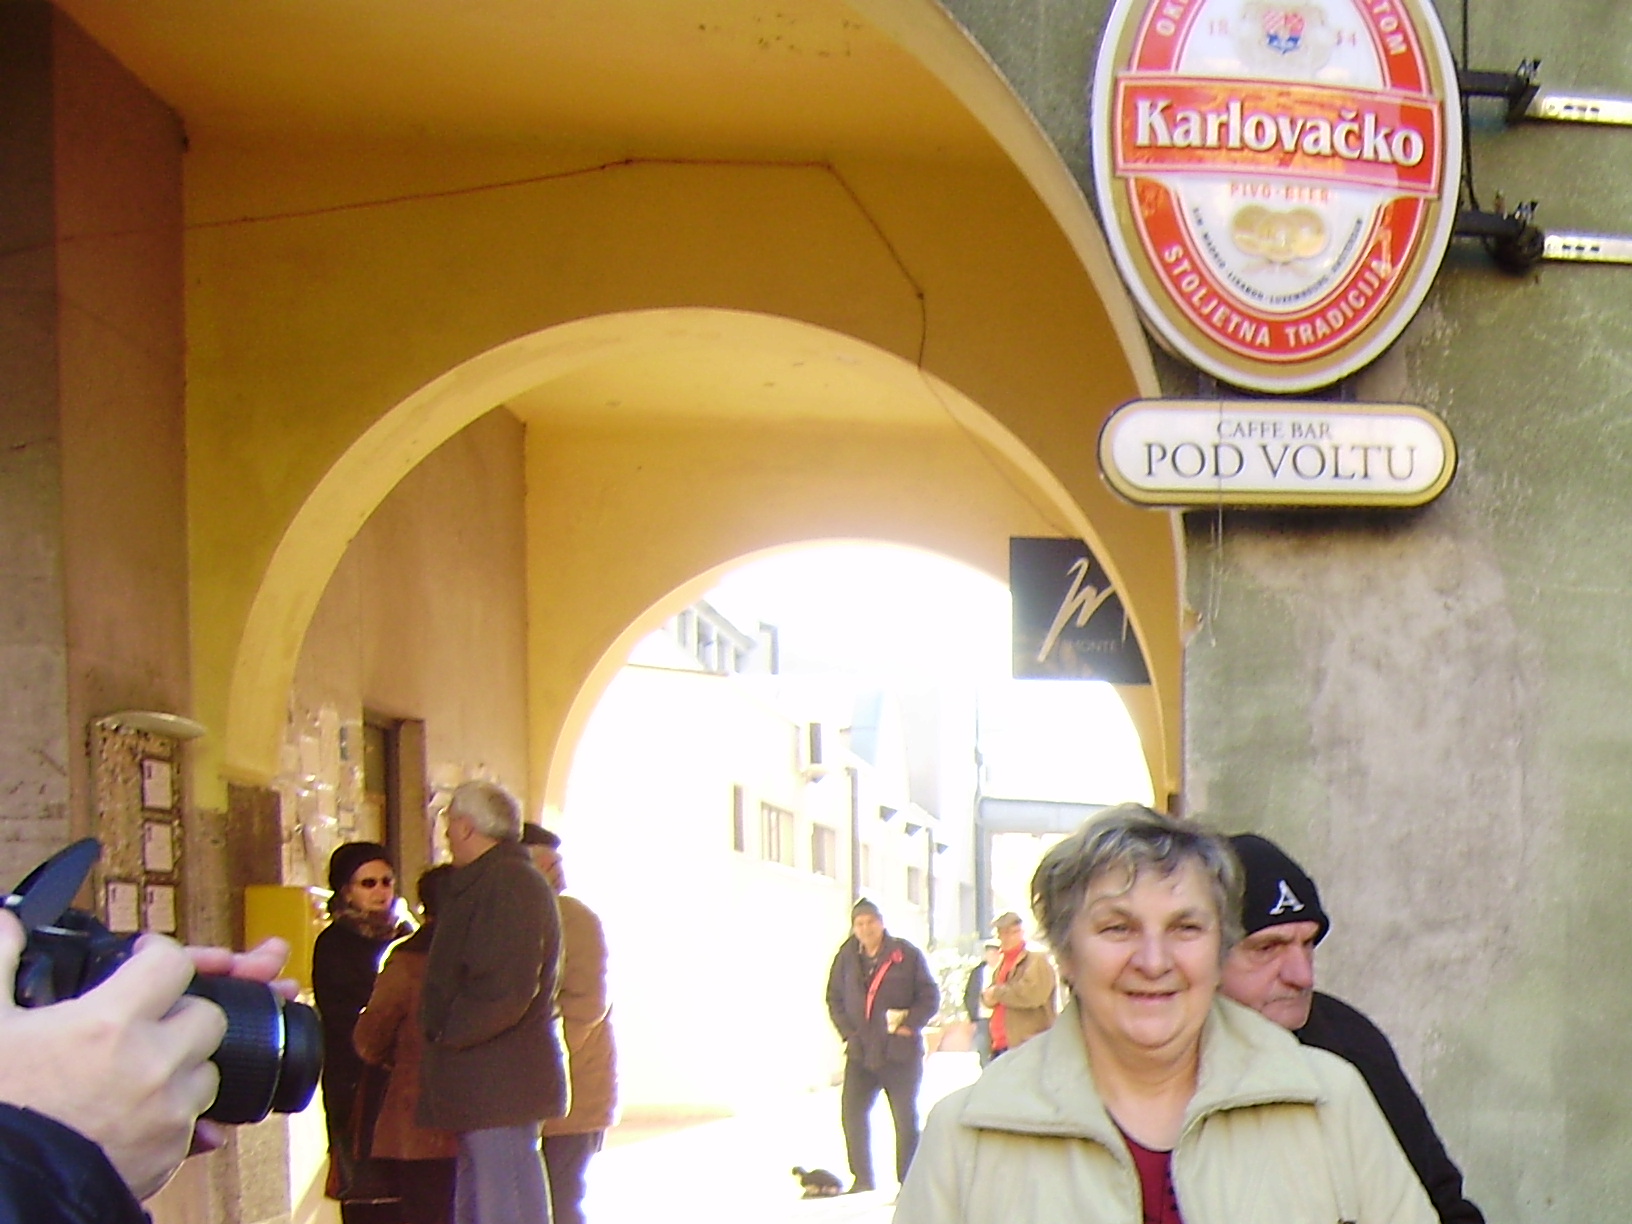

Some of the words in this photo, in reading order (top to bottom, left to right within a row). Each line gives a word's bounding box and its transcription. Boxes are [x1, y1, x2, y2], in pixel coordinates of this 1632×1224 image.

[1135, 98, 1424, 167] Karlovačko
[1163, 244, 1272, 348] STOLJETNA
[1284, 259, 1392, 348] TRADICIJA
[1216, 420, 1286, 440] CAFFE
[1291, 421, 1332, 441] BAR
[1144, 442, 1245, 479] POD
[1260, 443, 1417, 481] VOLTU
[1268, 879, 1305, 915] A
